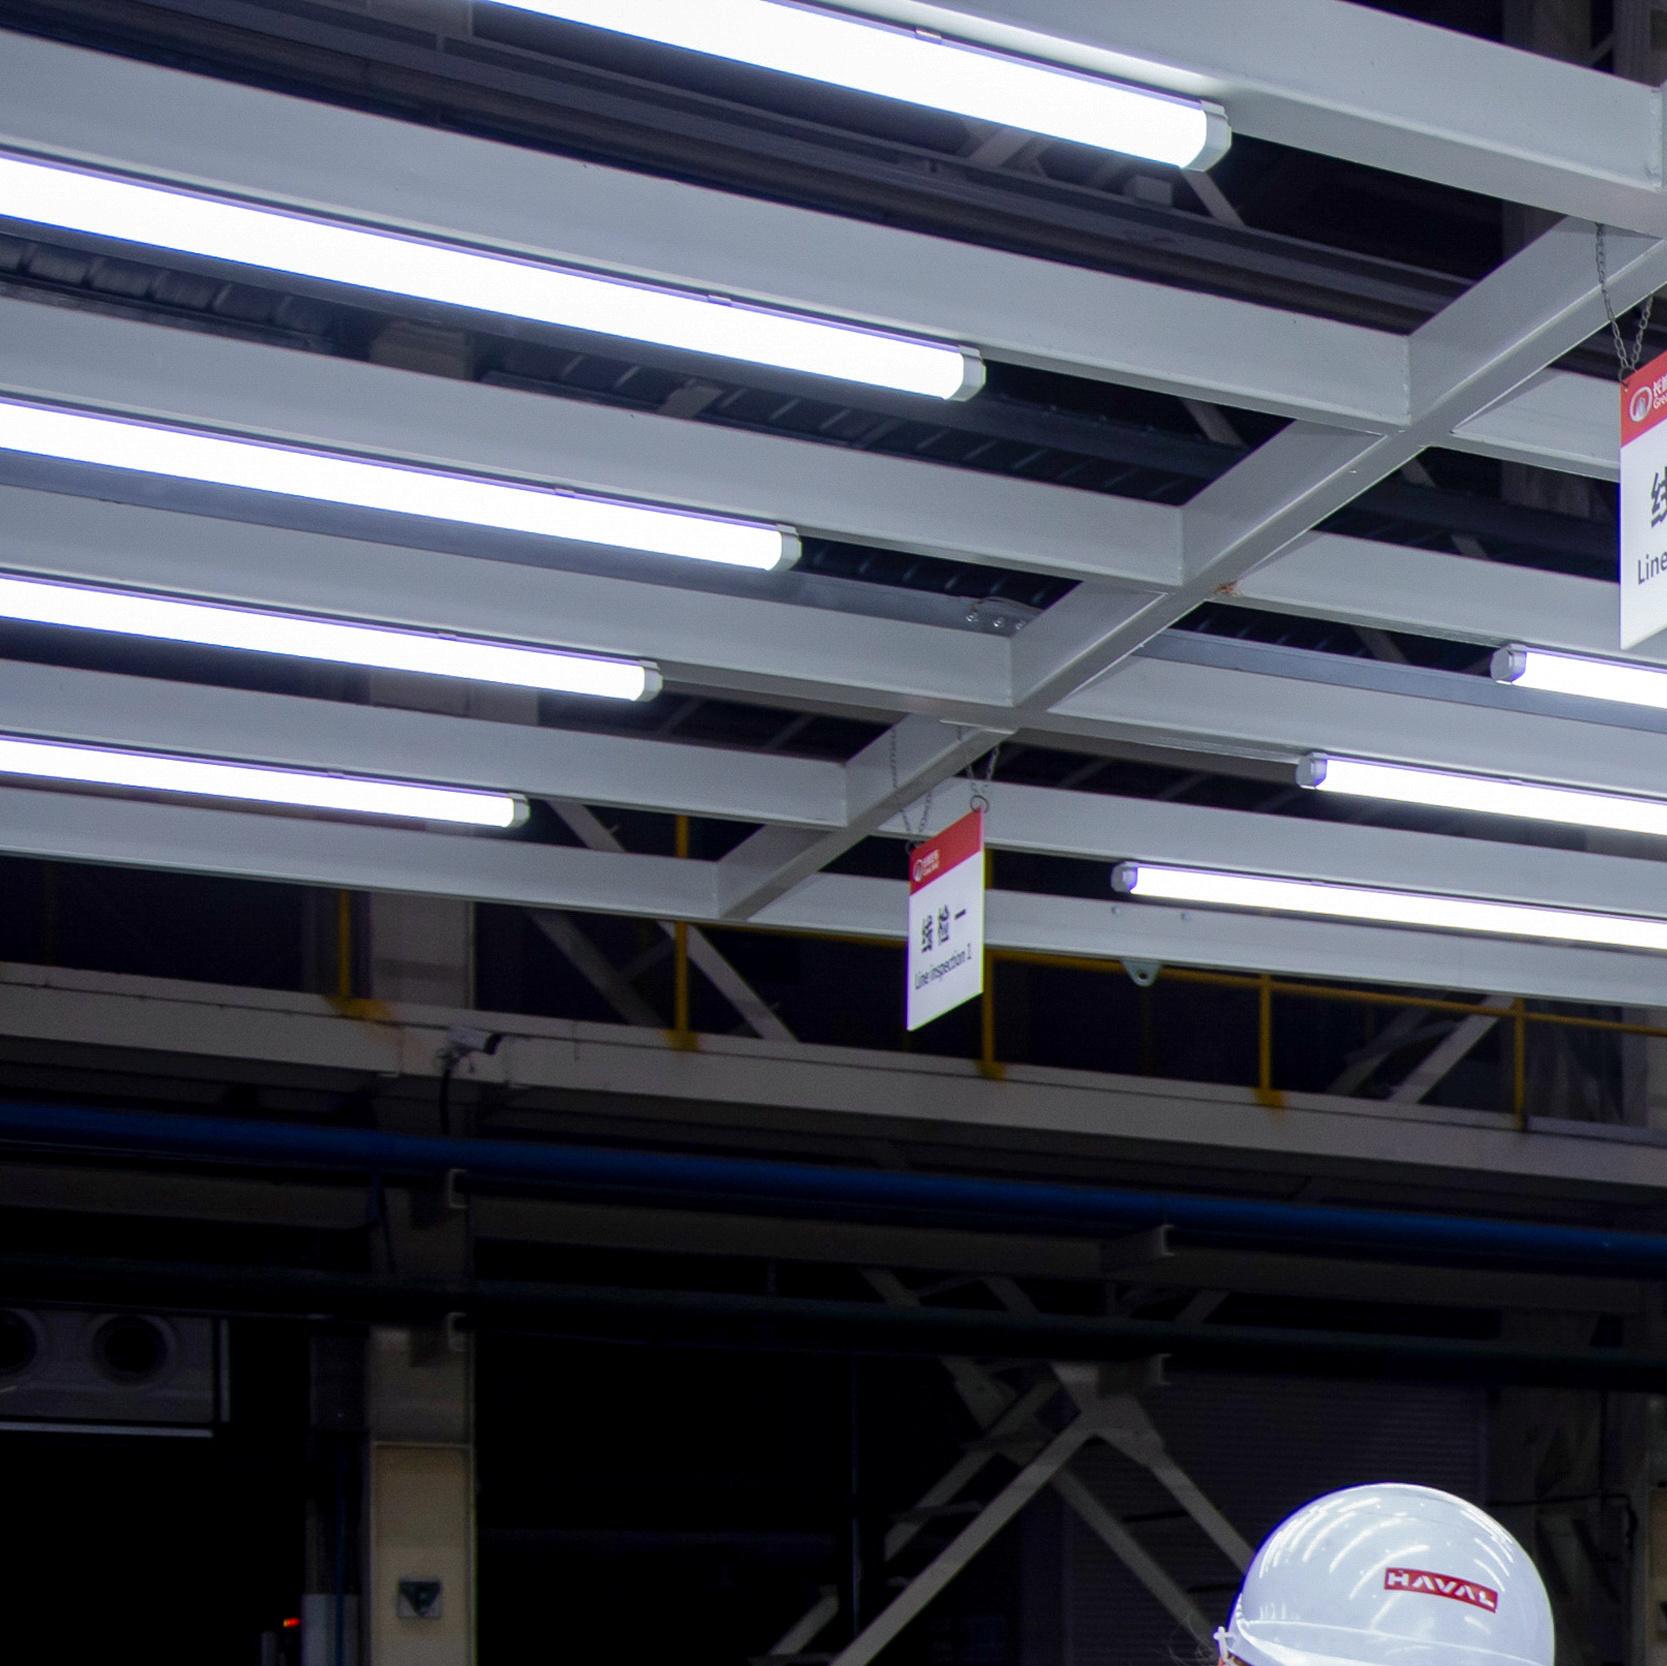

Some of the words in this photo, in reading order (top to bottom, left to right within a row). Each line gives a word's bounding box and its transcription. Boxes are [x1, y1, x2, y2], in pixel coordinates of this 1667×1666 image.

[1637, 546, 1667, 585] Line
[930, 949, 966, 982] inspection
[1387, 1570, 1496, 1609] HAVAL
